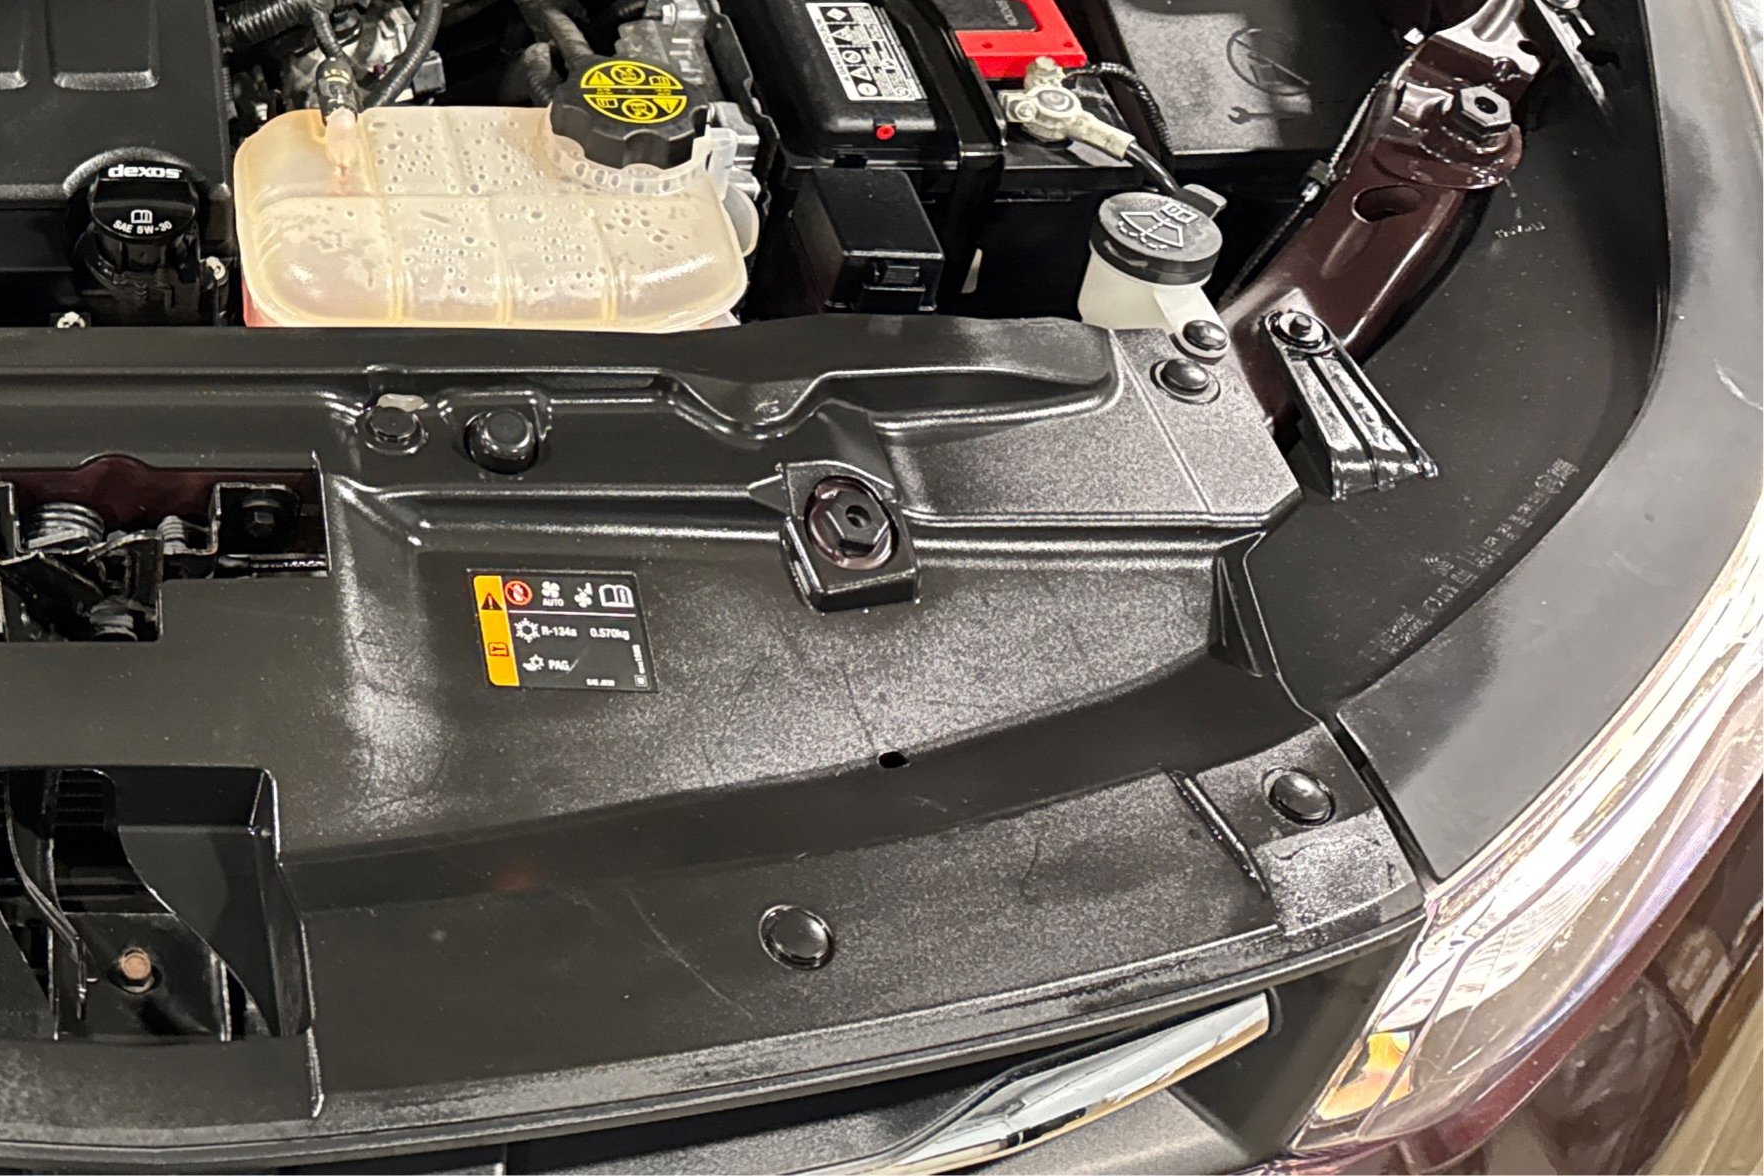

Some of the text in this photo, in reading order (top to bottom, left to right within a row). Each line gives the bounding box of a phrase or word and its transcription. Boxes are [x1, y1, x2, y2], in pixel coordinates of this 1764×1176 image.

[107, 164, 181, 179] dexos
[112, 220, 173, 234] SAE 5W-30
[542, 598, 565, 607] AUTO
[541, 626, 630, 640] R-134a 0.570kg
[548, 660, 570, 672] PAG
